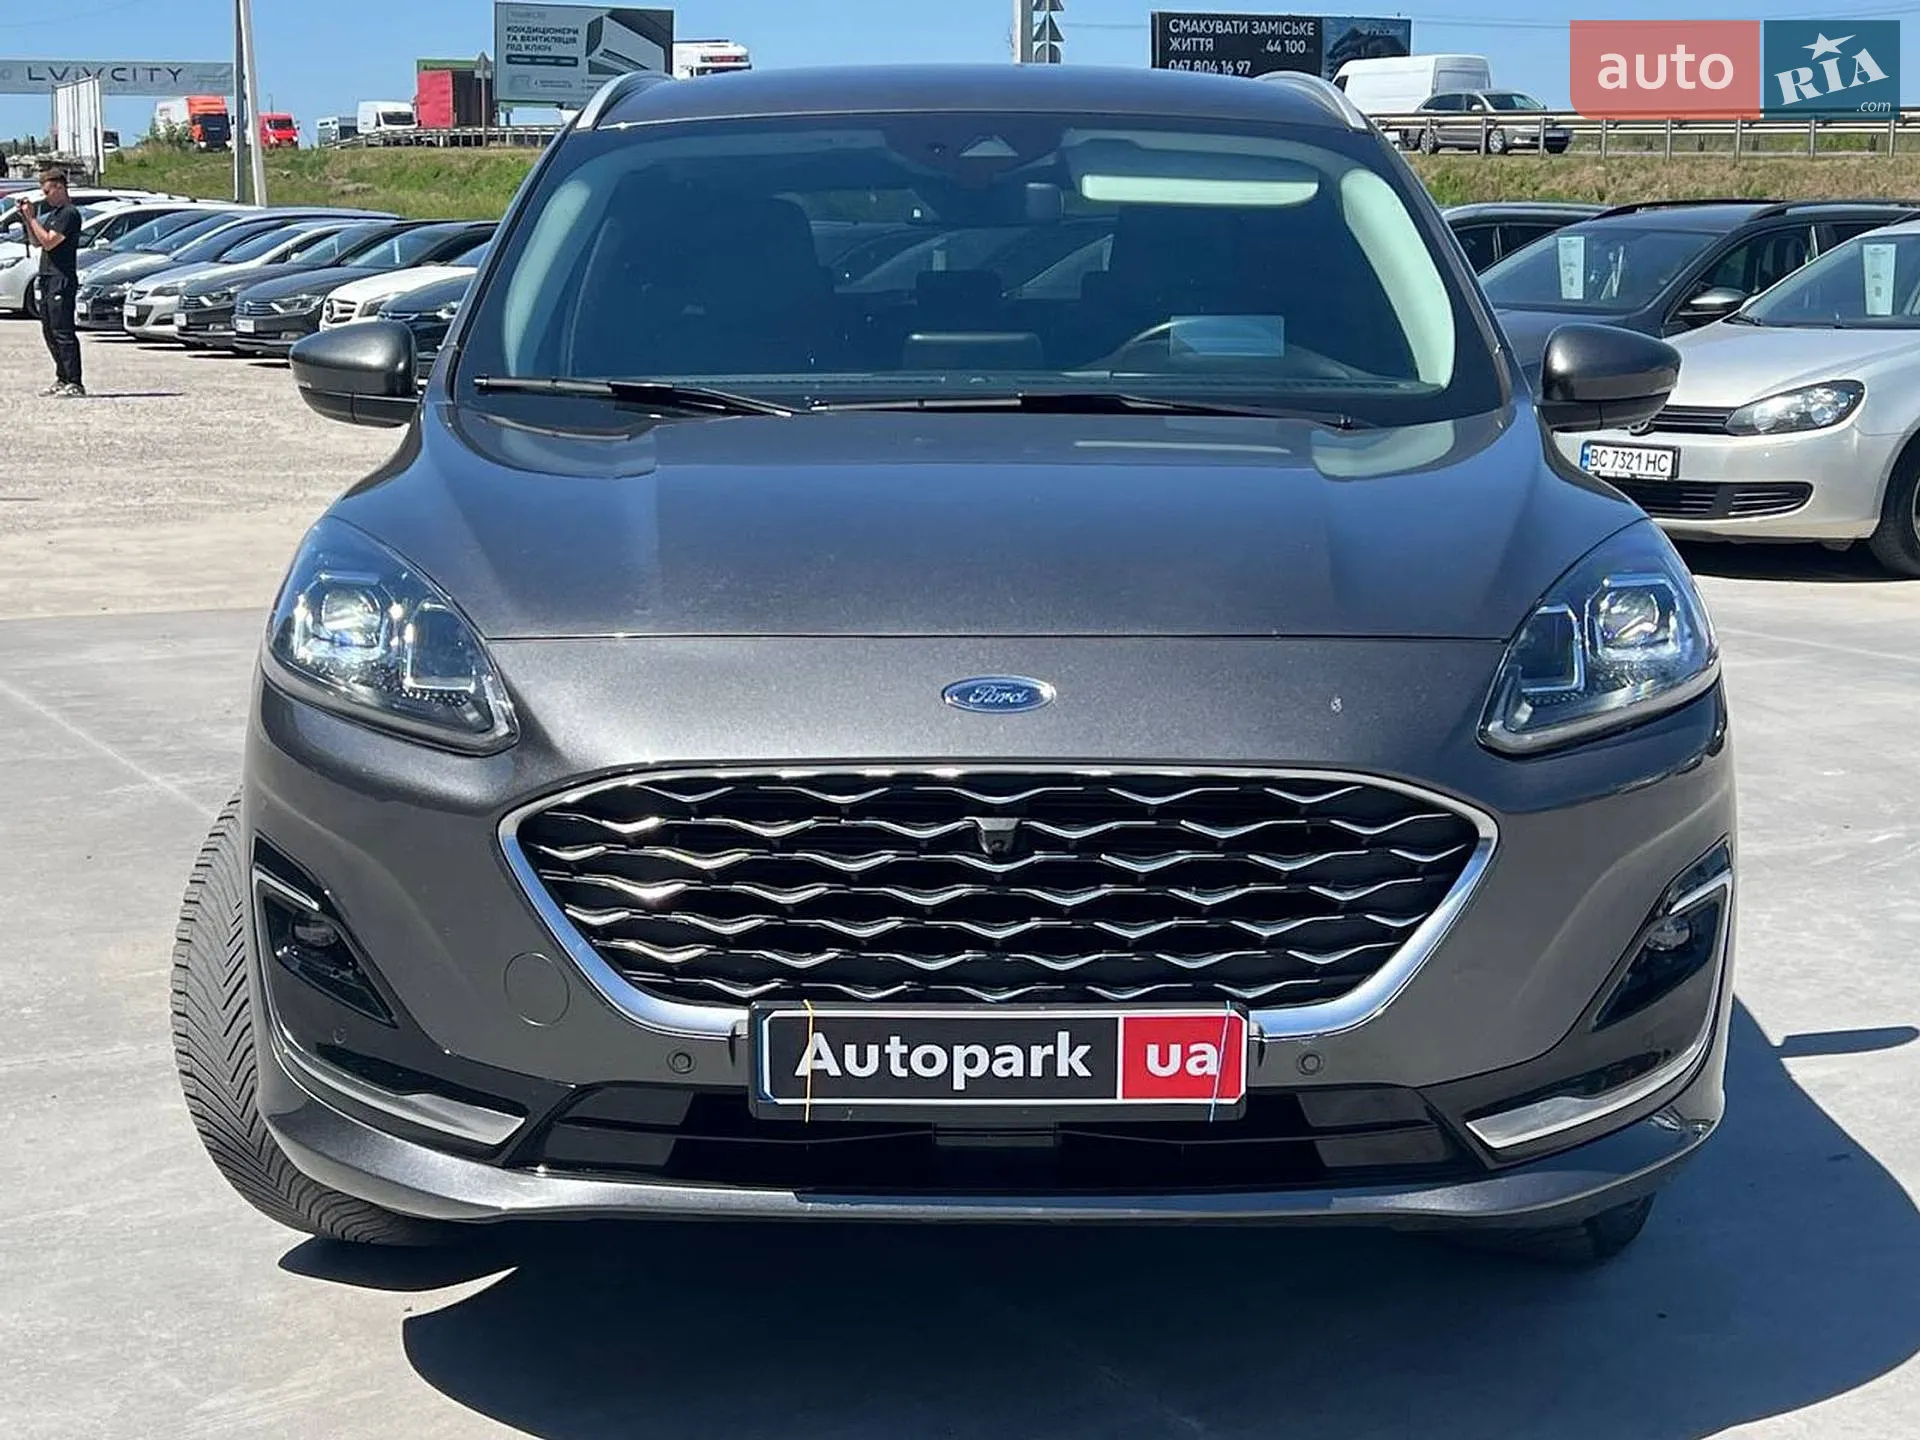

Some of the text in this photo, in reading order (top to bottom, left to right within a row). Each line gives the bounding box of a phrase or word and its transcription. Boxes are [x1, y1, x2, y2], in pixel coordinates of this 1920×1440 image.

[1168, 18, 1315, 37] СМАКУВАТИ ЗАМІСЬКЕ
[1168, 37, 1214, 52] ЖИТТЯ
[1236, 60, 1251, 74] 97
[1589, 448, 1669, 473] BC 7321 HC
[968, 685, 1029, 704] Ford
[794, 1030, 1221, 1091] Autopark ua
